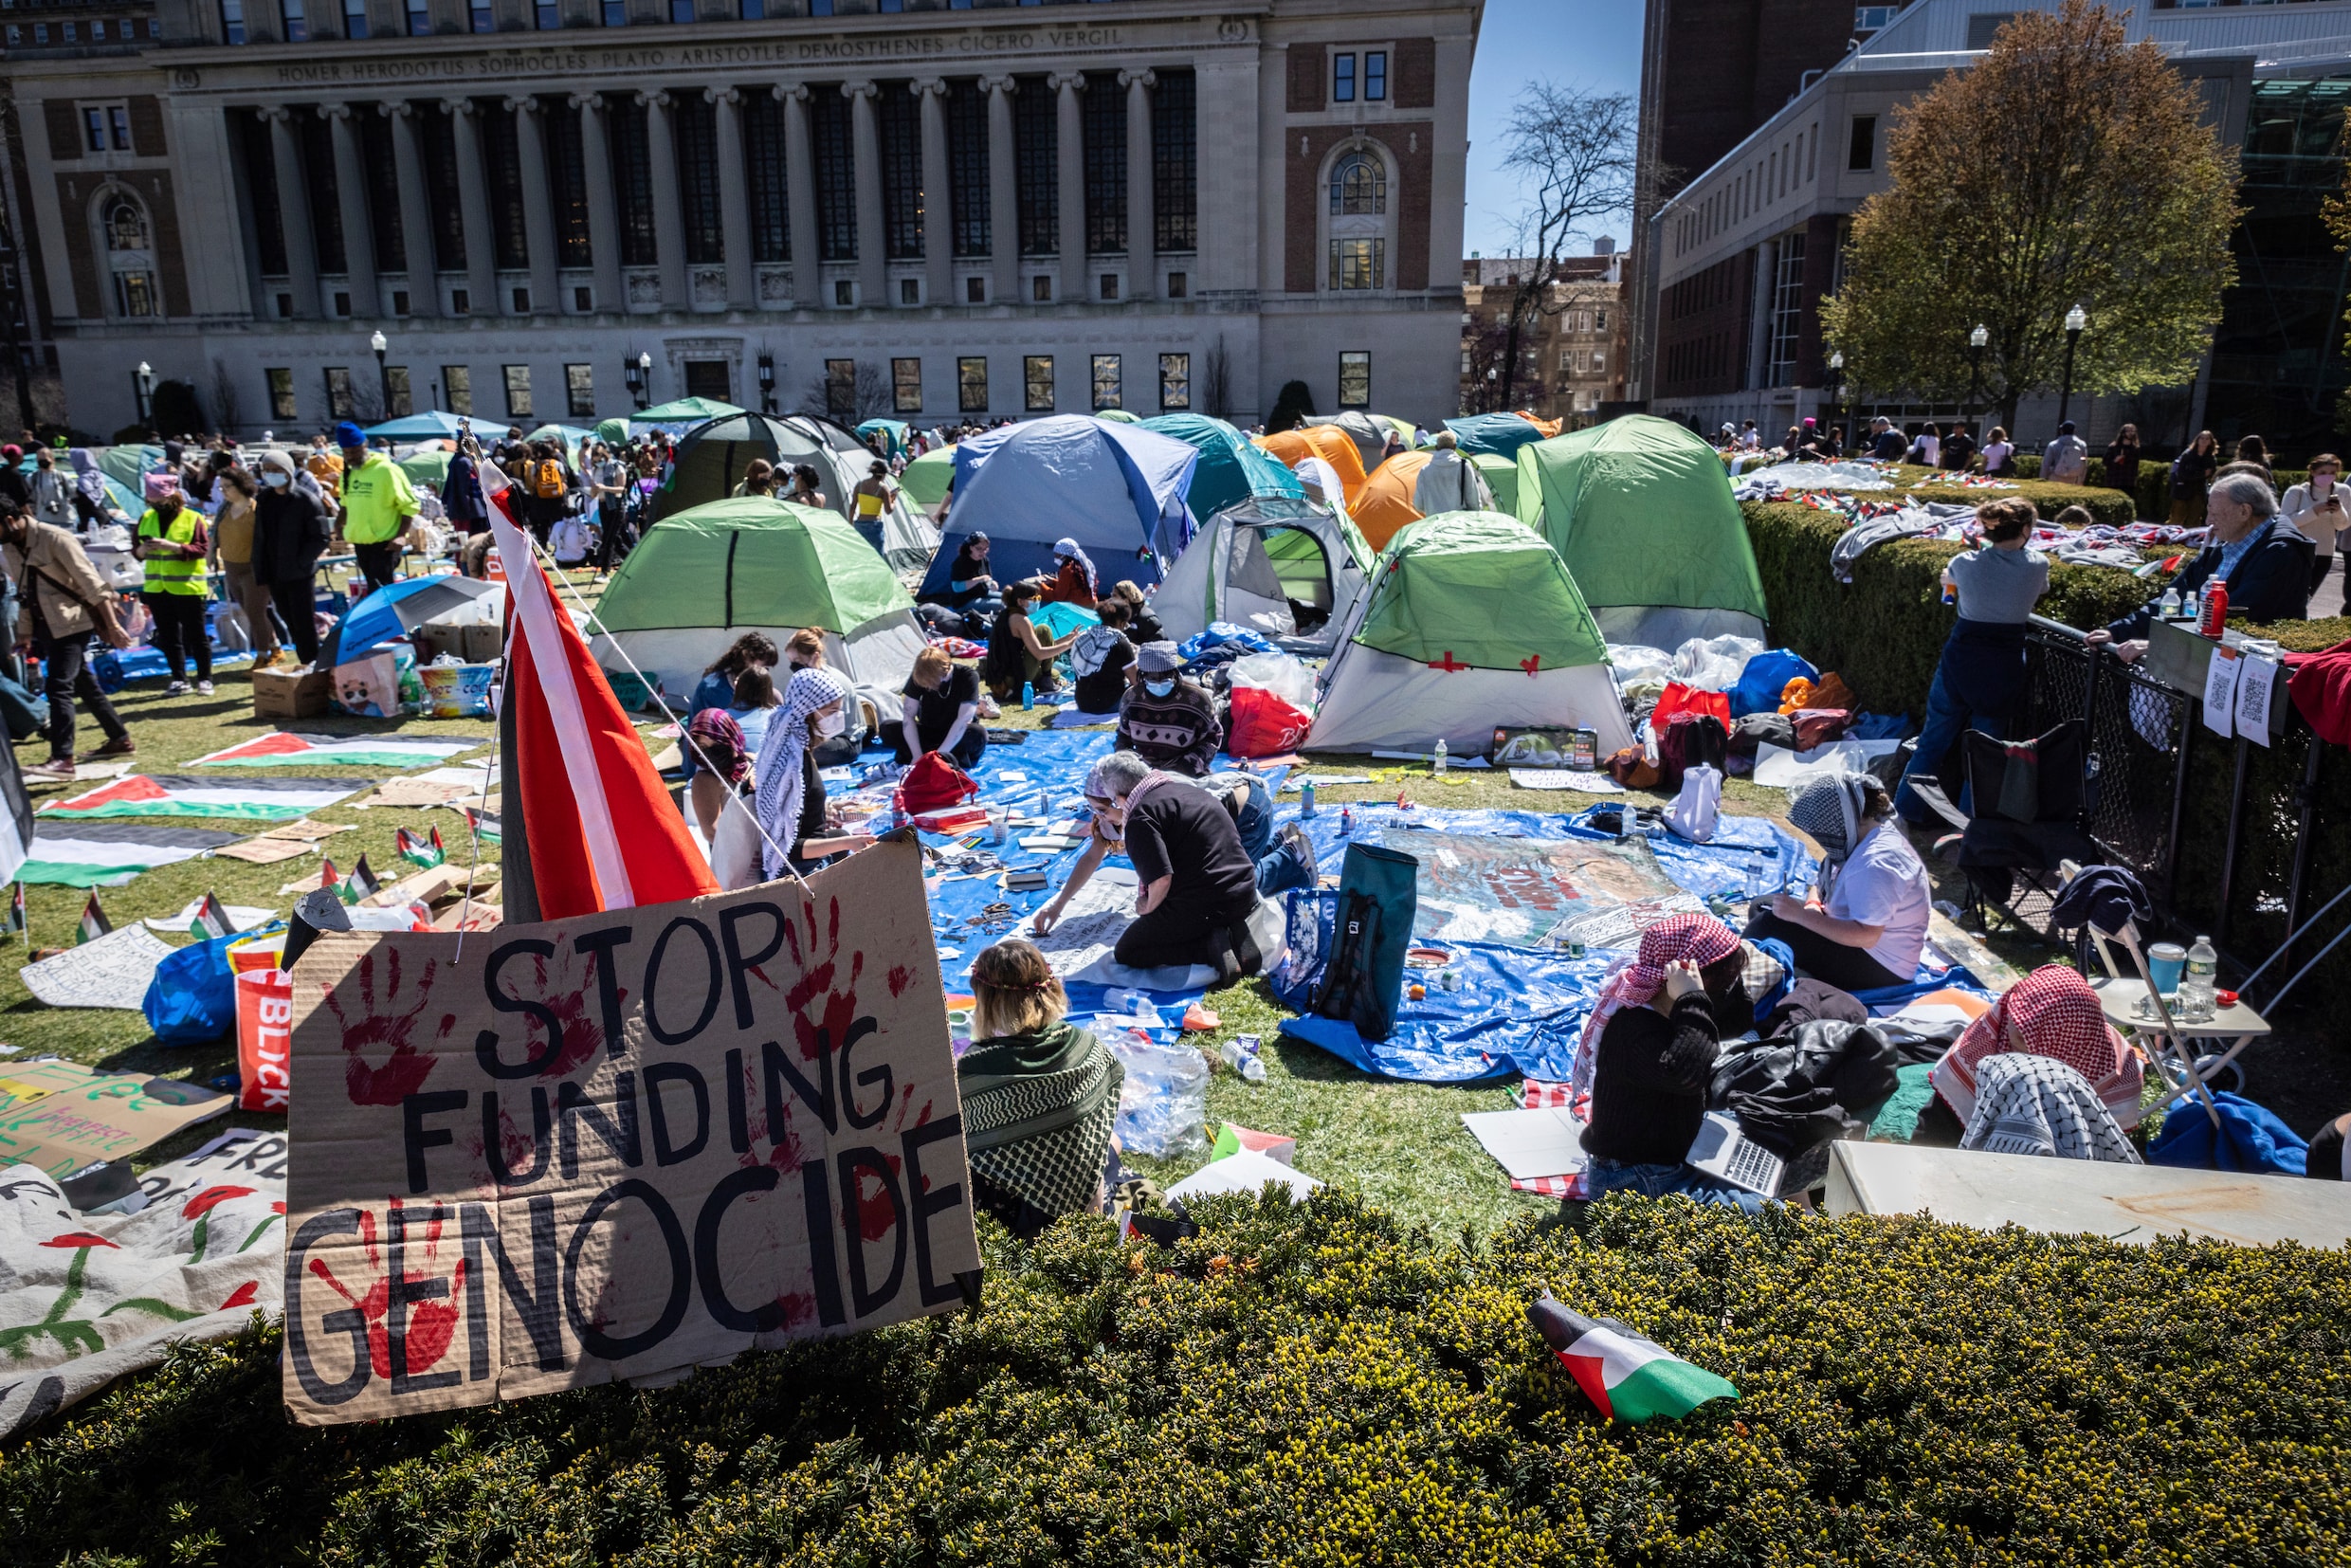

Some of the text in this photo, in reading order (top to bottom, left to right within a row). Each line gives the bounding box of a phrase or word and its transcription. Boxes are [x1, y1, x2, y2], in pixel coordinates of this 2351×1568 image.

[278, 28, 1123, 82] HOMER HERODOTUS SOPHOCLES PLATO ARISTOTLE DEMOSTHENES CICERO VERGIL
[2202, 597, 2214, 629] PRIME
[257, 996, 292, 1108] BLICK
[474, 902, 786, 1080] STOP
[402, 1015, 893, 1194] FUNDING
[284, 1113, 965, 1406] GENOCIDE
